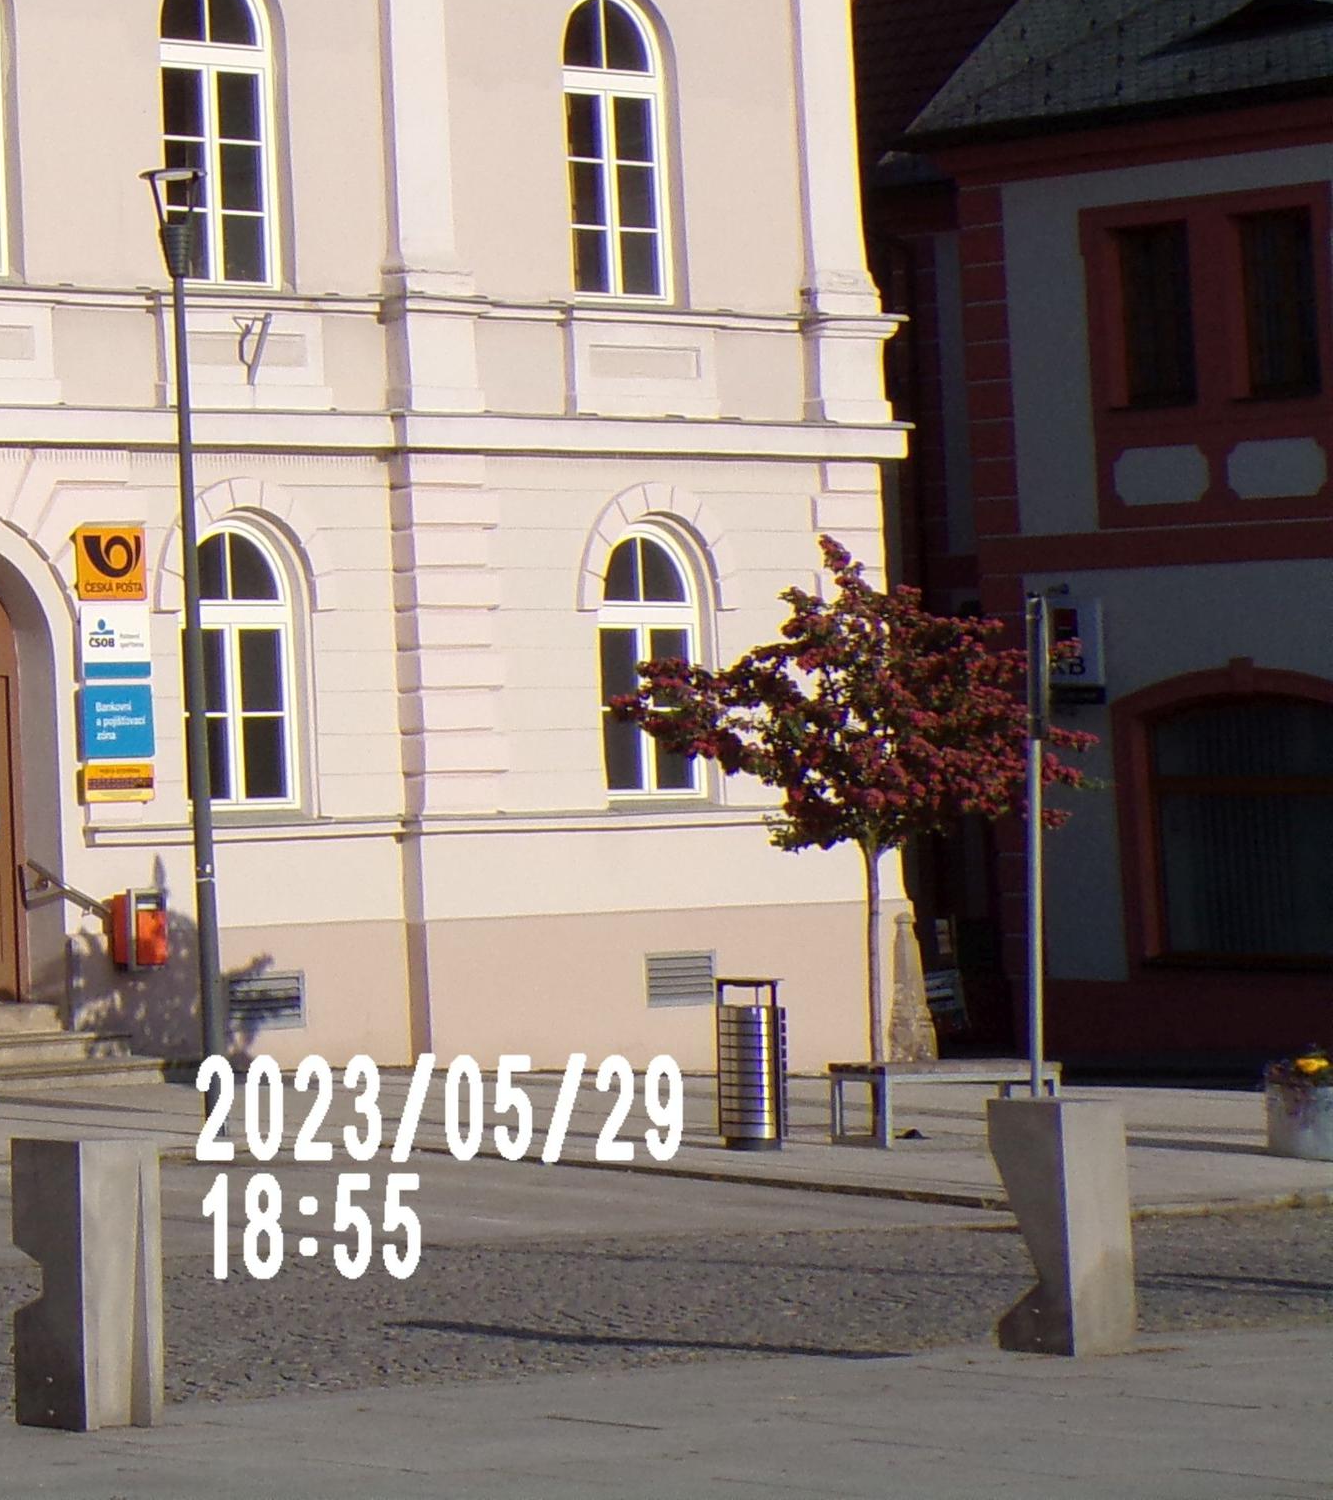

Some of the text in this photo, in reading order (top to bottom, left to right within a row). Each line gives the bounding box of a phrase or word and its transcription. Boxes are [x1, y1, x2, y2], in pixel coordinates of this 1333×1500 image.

[84, 580, 144, 593] ČESKÁ POŠTA
[89, 636, 115, 648] ČSOB
[95, 701, 132, 712] Bankovní
